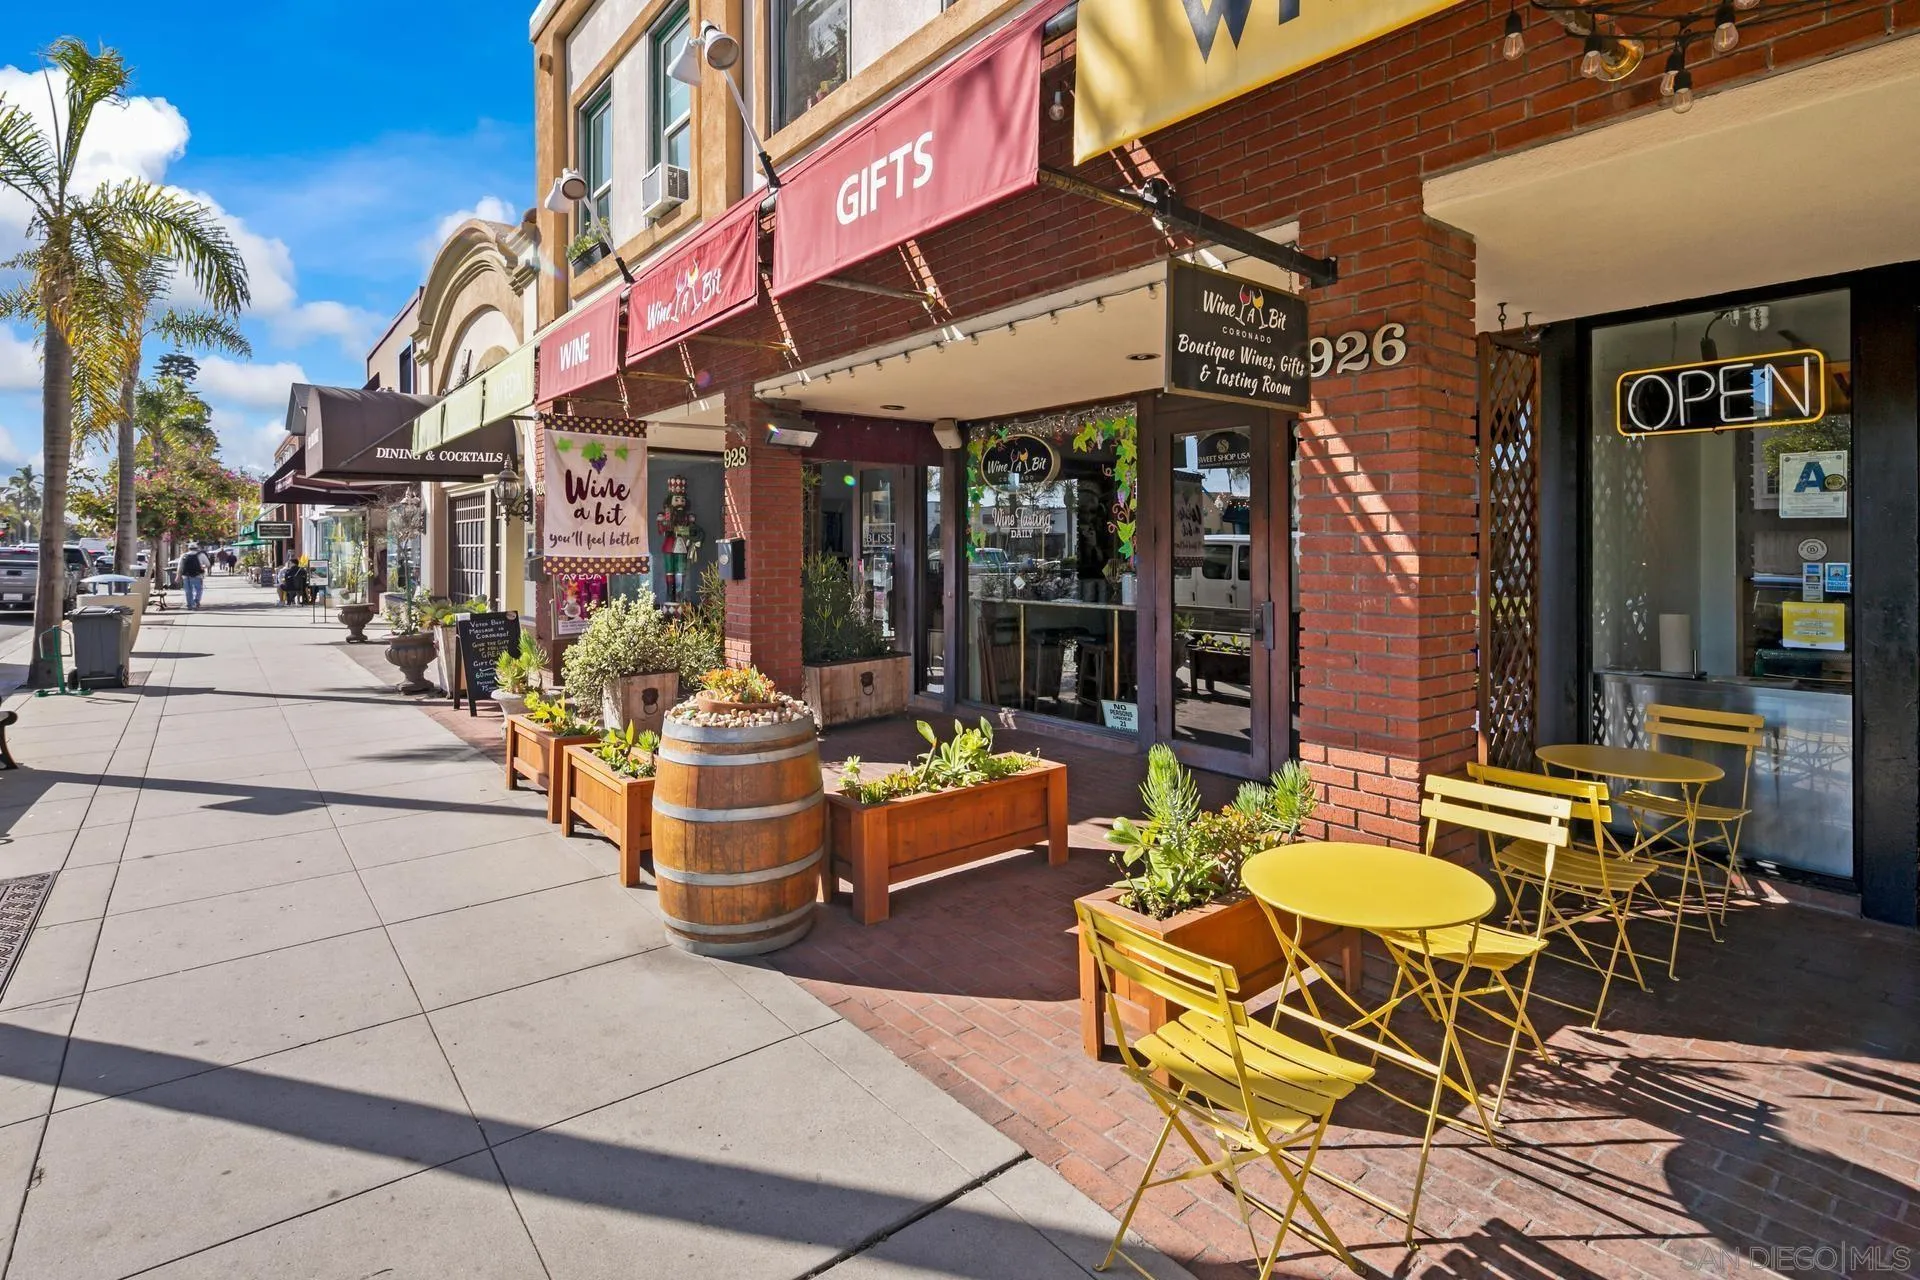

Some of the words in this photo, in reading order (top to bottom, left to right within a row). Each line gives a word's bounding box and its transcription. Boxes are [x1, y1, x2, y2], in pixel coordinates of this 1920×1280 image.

[836, 131, 934, 226] GIFTS
[646, 301, 673, 331] Wine
[681, 291, 690, 315] A
[701, 268, 722, 303] Bit
[1203, 290, 1236, 317] Wine
[1246, 308, 1255, 323] A
[1268, 308, 1287, 330] Bit
[1222, 326, 1272, 344] CORONADO
[1310, 323, 1407, 378] 926
[560, 331, 590, 372] WINE
[1178, 333, 1236, 365] Boutique
[1240, 346, 1276, 371] Wines,
[1280, 355, 1305, 378] Gifts
[1200, 364, 1211, 382] &
[1216, 366, 1258, 396] Tasting
[1262, 375, 1291, 396] Room
[1627, 356, 1811, 431] OPEN
[375, 447, 421, 460] DINING
[425, 450, 436, 461] &
[439, 450, 503, 463] COCKTAILS
[724, 446, 747, 469] 928
[987, 460, 1008, 474] Wine
[1031, 456, 1047, 471] Bit
[1217, 453, 1236, 462] SHOP
[1236, 452, 1251, 460] USA
[565, 469, 630, 504] Wine
[1793, 461, 1826, 493] A
[573, 507, 590, 520] a
[594, 501, 627, 526] bit
[991, 507, 1015, 528] Wine
[1015, 507, 1053, 534] Tasting
[549, 530, 583, 548] you'll
[587, 532, 606, 550] feel
[609, 531, 640, 546] better
[1010, 529, 1034, 538] DAILY
